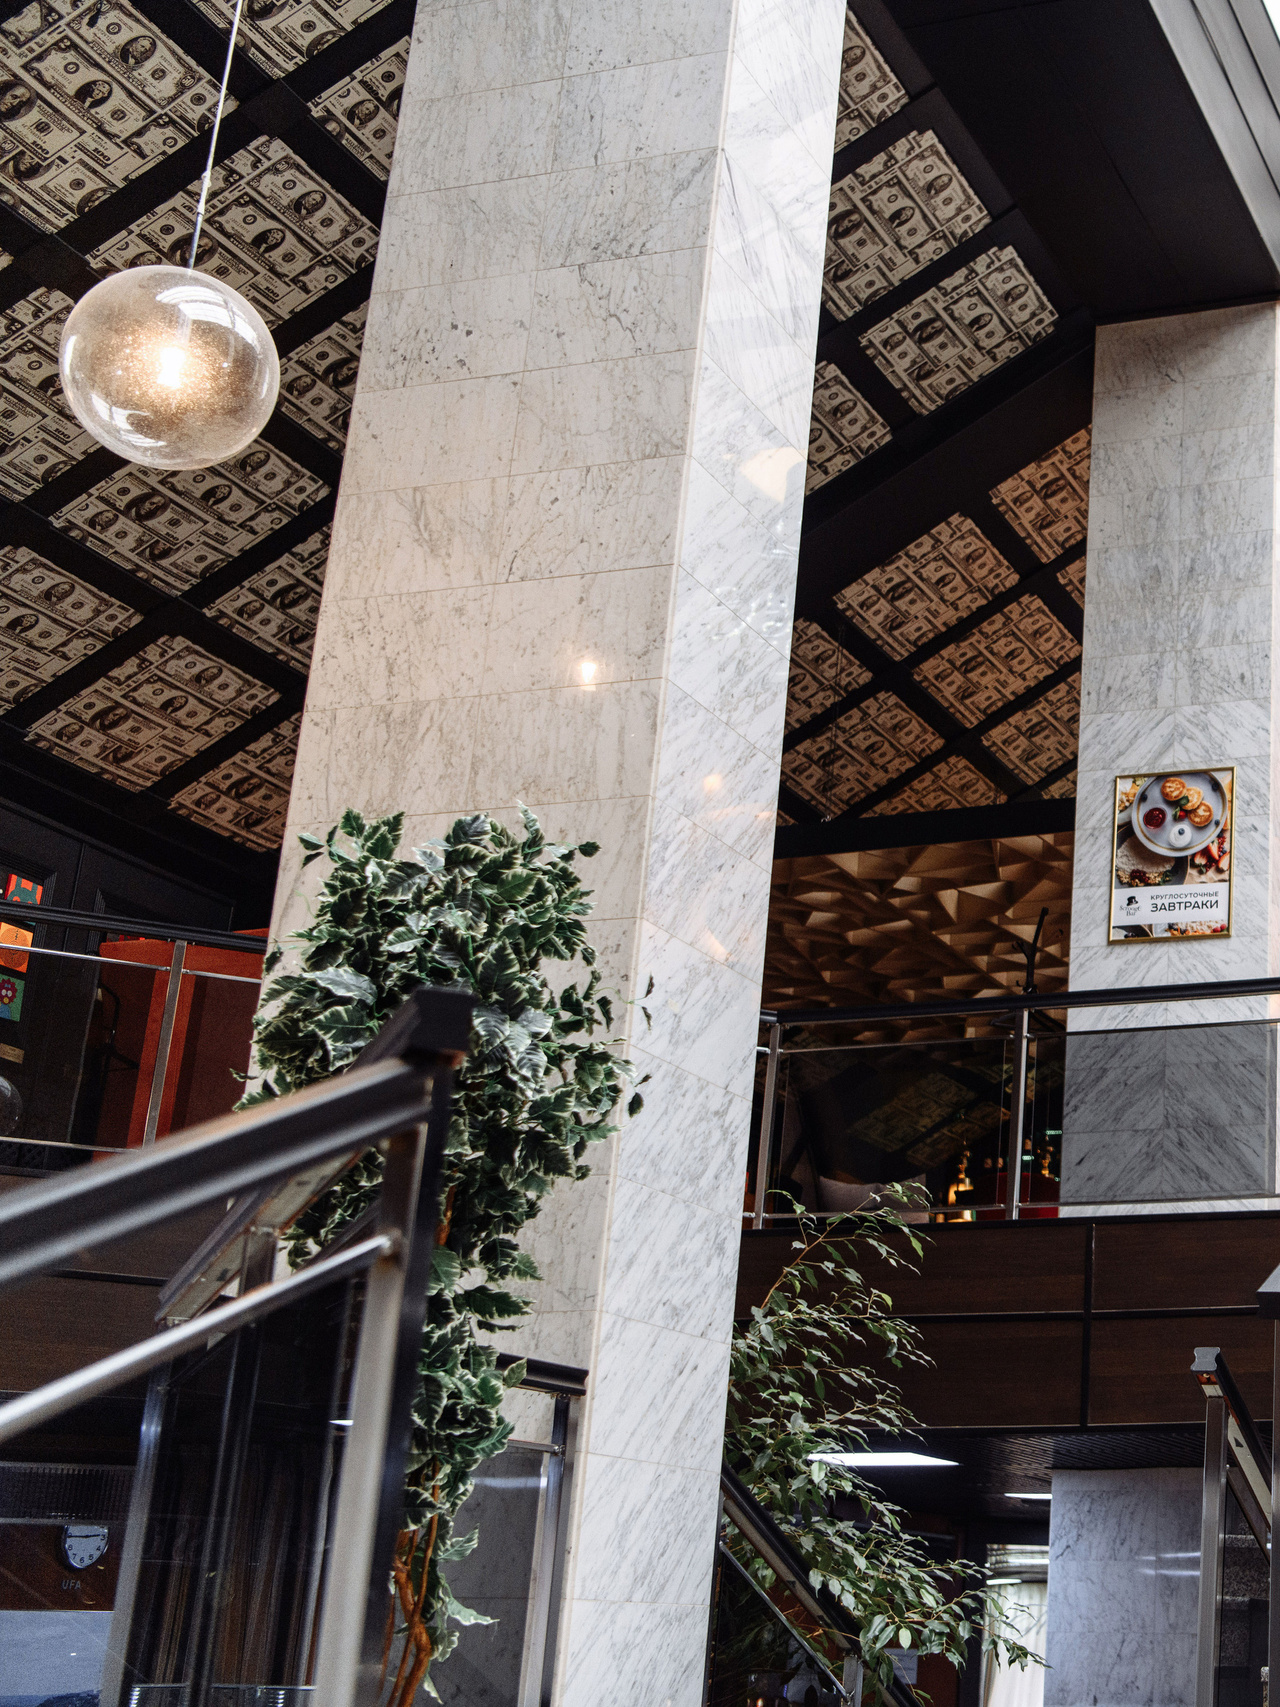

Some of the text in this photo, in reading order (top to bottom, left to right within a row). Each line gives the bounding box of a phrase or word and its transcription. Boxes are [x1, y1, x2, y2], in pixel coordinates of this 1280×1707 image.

[1150, 891, 1219, 901] КРУГЛОСУТОЧНЫЕ
[1150, 900, 1219, 912] ЗАВТРАКИ
[62, 1580, 81, 1590] UFA
